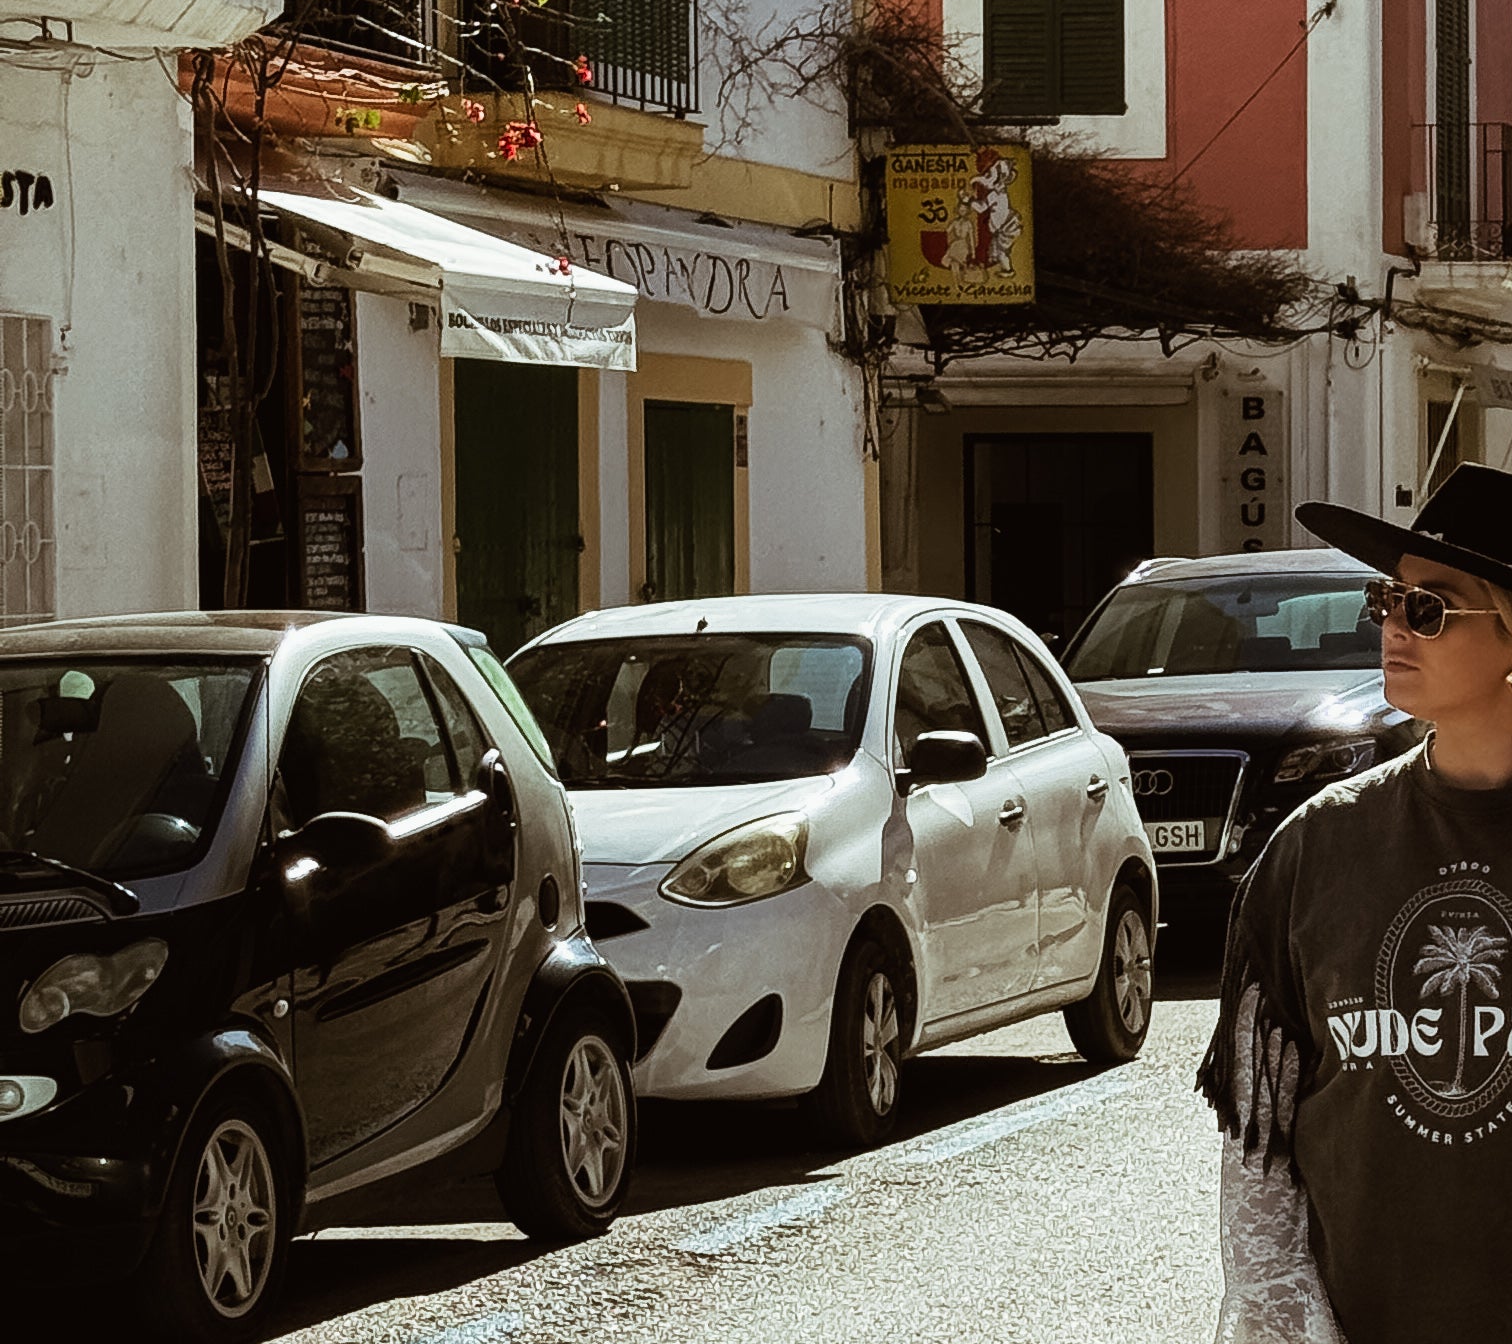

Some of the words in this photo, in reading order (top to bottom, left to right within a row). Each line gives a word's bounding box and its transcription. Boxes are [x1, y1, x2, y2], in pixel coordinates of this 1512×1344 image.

[891, 153, 970, 173] GANESHA
[894, 281, 951, 297] Vicente
[1327, 1008, 1443, 1060] NUDE
[1387, 1094, 1453, 1145] SUMMER
